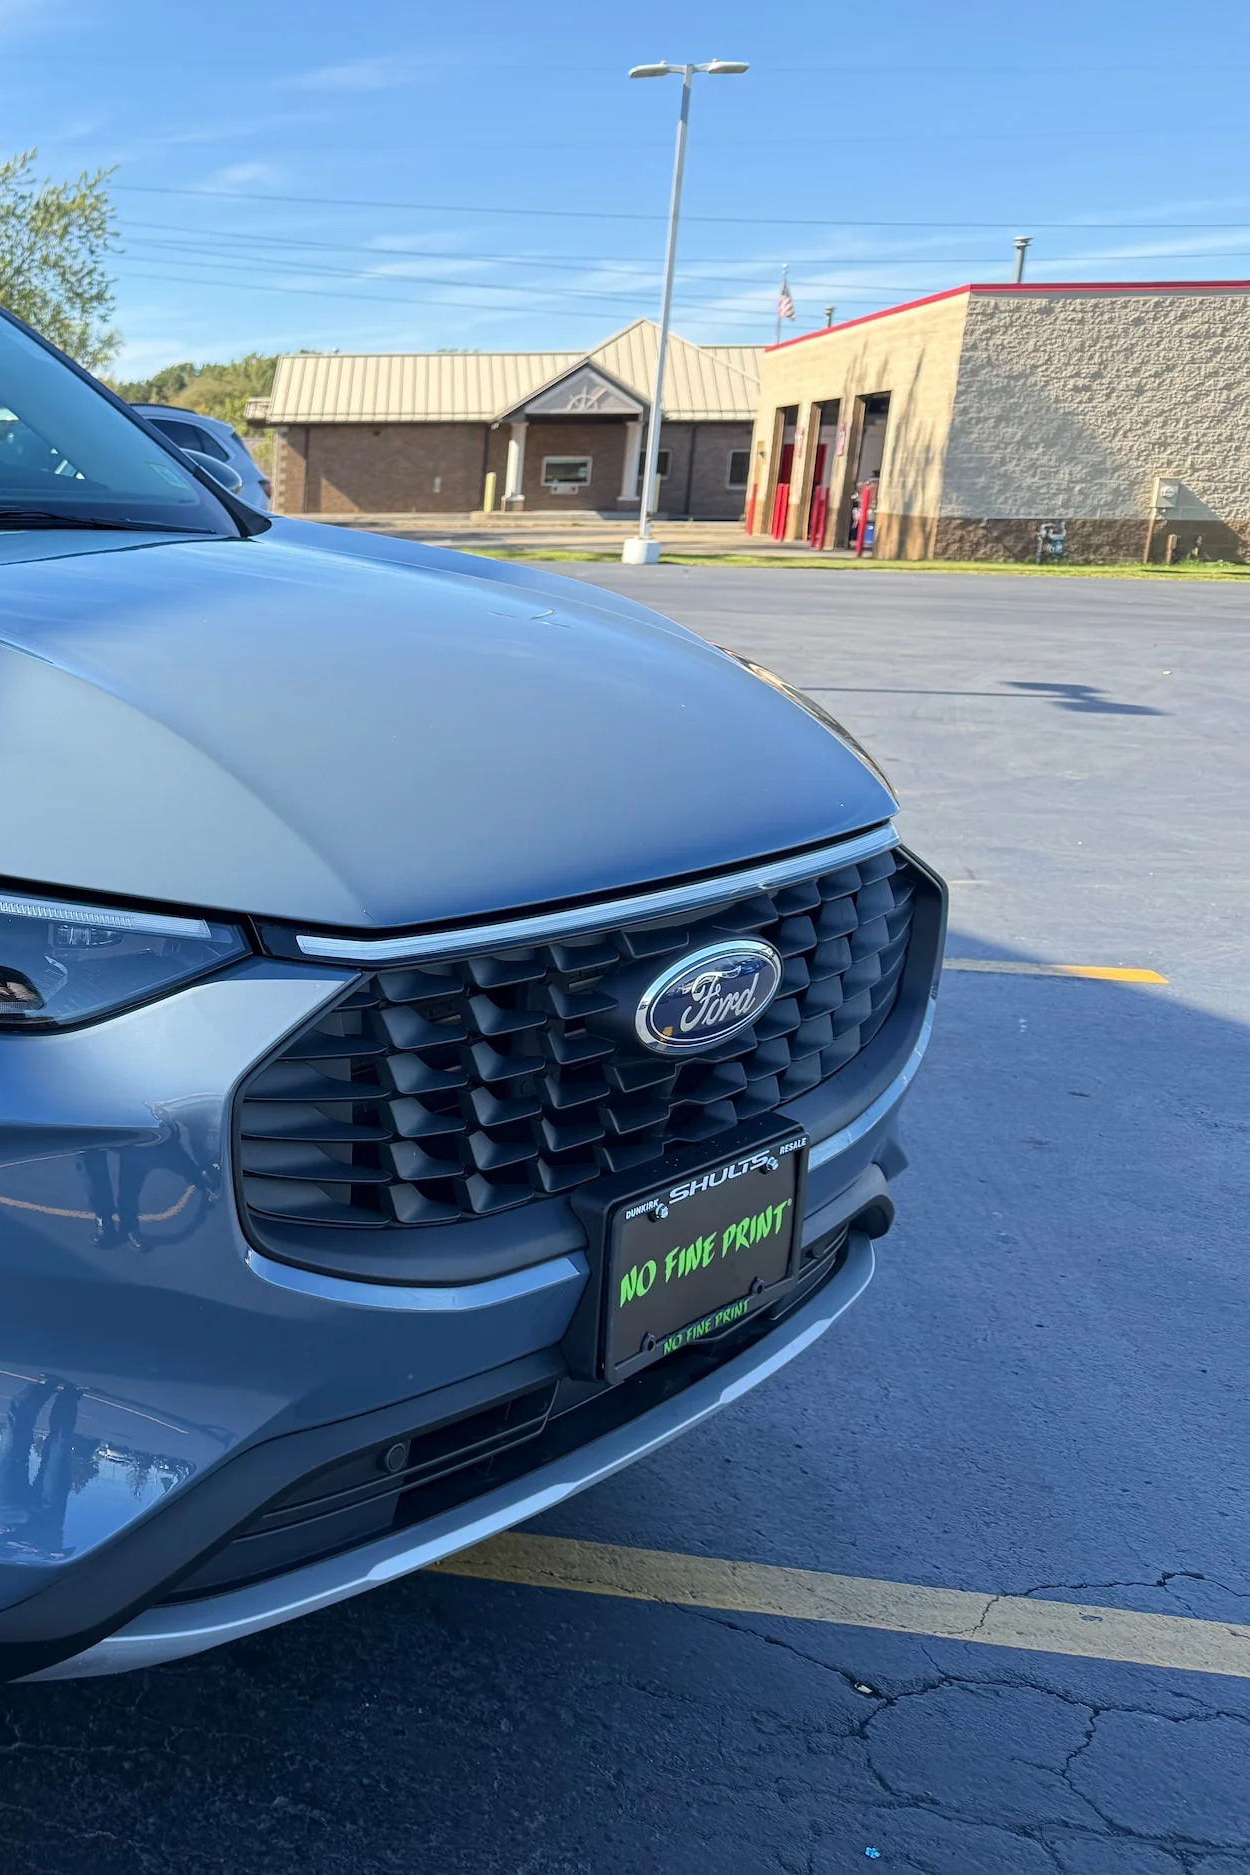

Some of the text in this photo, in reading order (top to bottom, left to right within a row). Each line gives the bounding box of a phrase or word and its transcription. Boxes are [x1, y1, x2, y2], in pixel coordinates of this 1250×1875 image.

[680, 965, 759, 1033] Ford
[625, 1137, 807, 1220] DUNKIRK SHULTS RESALE
[620, 1260, 657, 1308] NO
[664, 1231, 718, 1283] FINE
[663, 1298, 750, 1356] NO FINE PRINT
